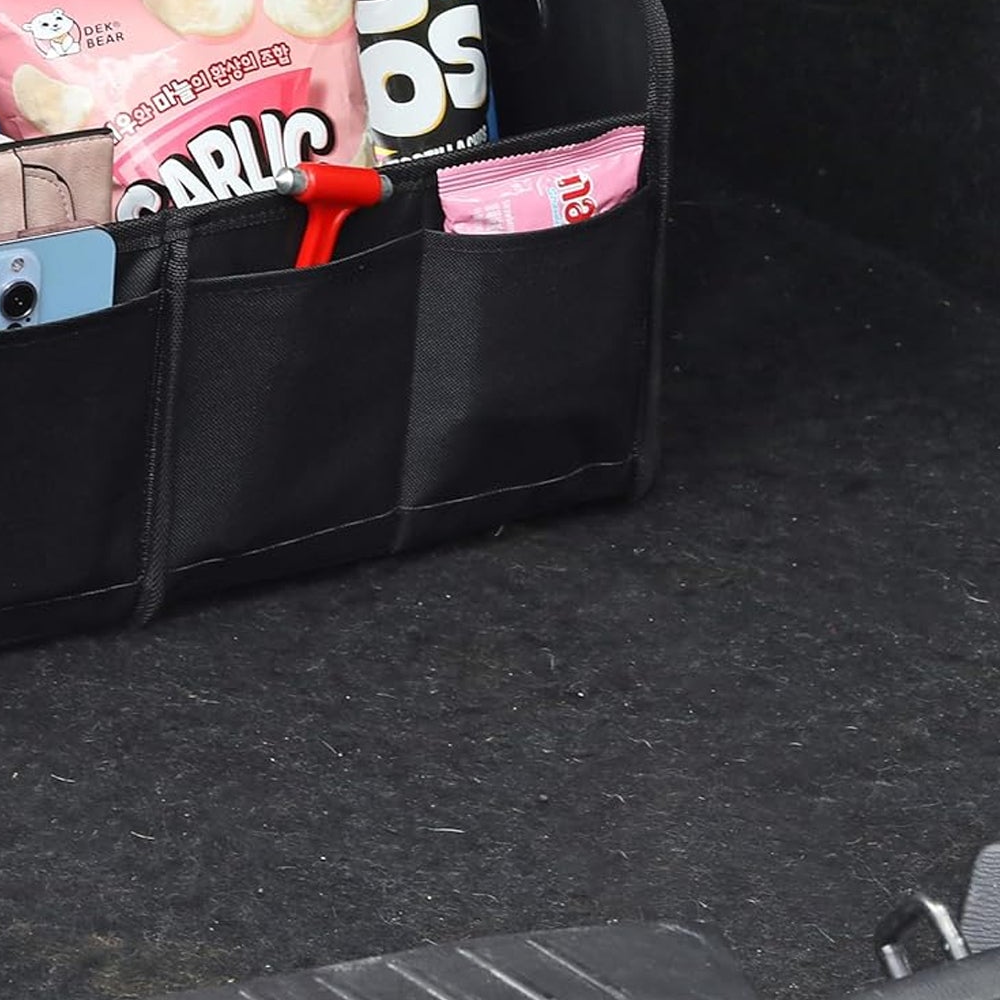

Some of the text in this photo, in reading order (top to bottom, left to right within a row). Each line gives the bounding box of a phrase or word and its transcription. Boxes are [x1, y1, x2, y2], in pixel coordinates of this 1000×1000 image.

[86, 31, 124, 49] BEAR
[151, 70, 211, 115] 마늘의
[208, 50, 260, 88] 환상의
[258, 42, 292, 68] 조합
